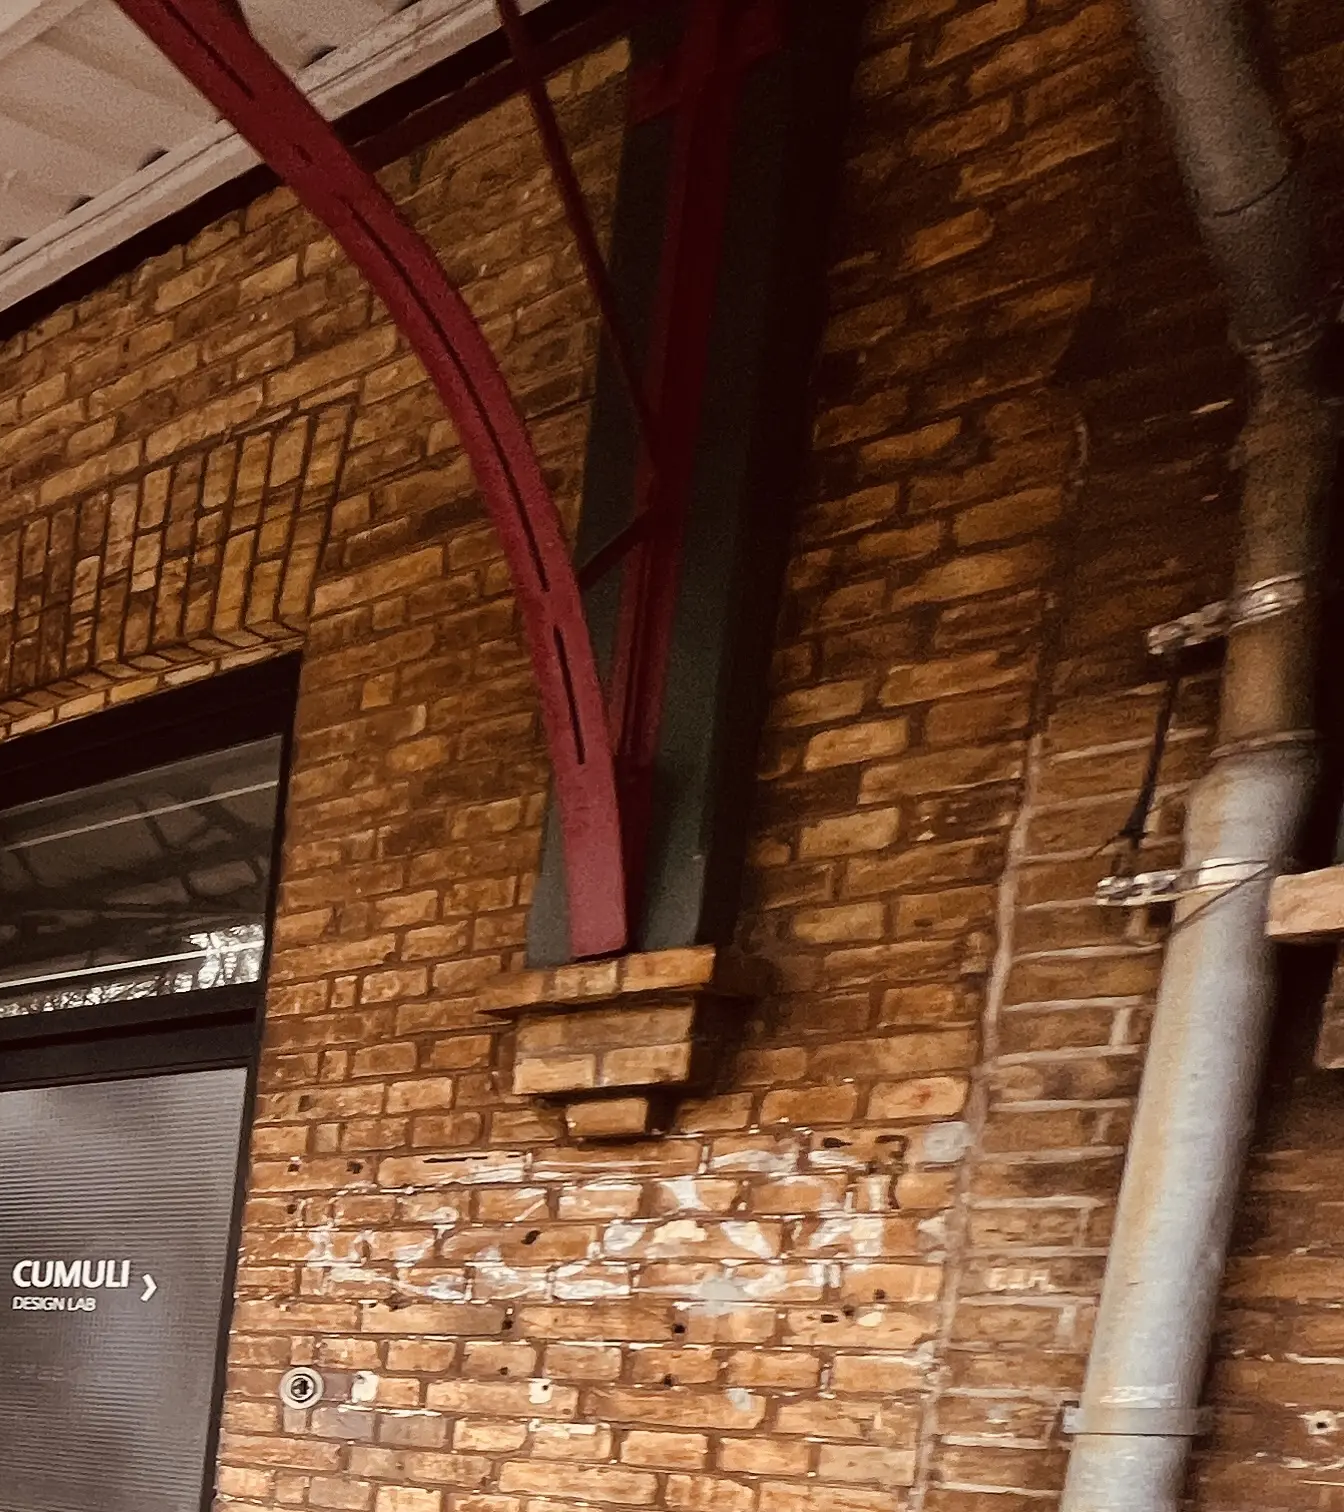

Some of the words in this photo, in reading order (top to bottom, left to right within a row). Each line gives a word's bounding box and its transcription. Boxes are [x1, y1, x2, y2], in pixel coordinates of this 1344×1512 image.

[12, 1259, 131, 1289] CUMULI
[12, 1296, 64, 1311] DESIGN
[67, 1297, 97, 1312] LAB
